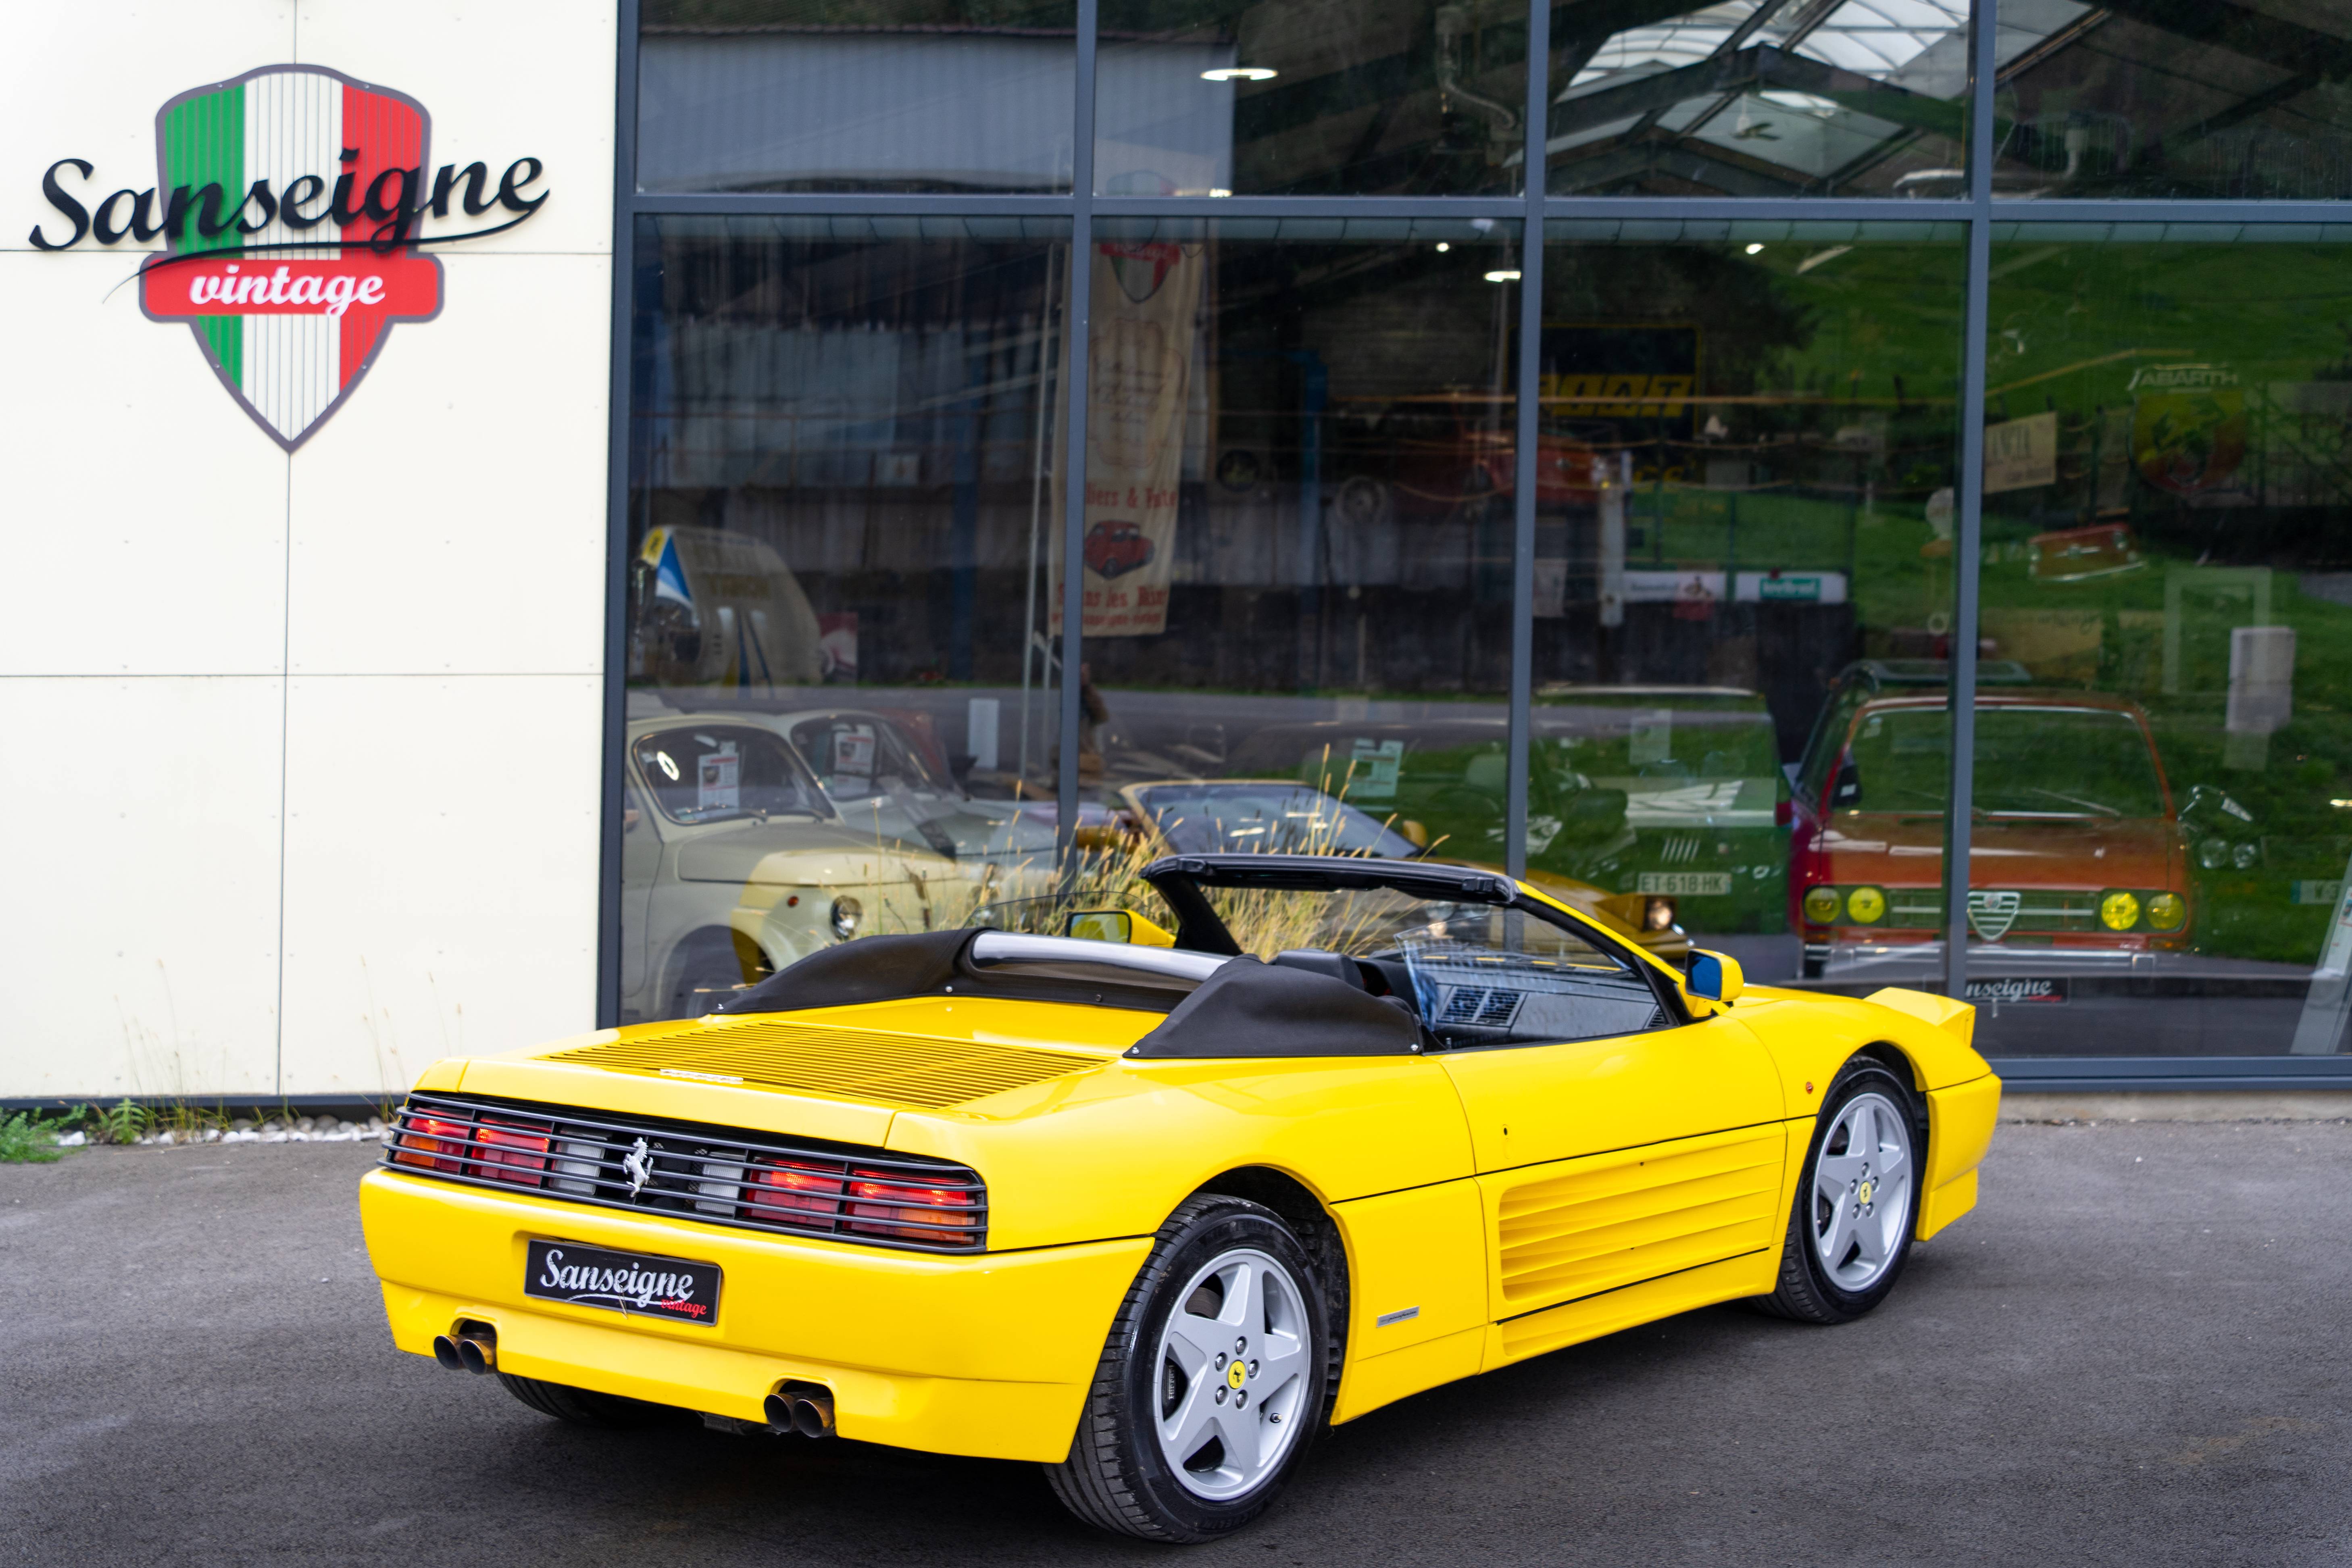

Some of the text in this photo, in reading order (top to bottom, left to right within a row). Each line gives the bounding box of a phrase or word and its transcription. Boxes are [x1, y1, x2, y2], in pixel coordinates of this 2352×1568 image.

[29, 148, 550, 252] Sanseigne
[189, 264, 386, 318] vintage
[2140, 370, 2238, 386] ABARTH
[540, 1249, 694, 1308] Sanseigne
[660, 1296, 707, 1318] vintage
